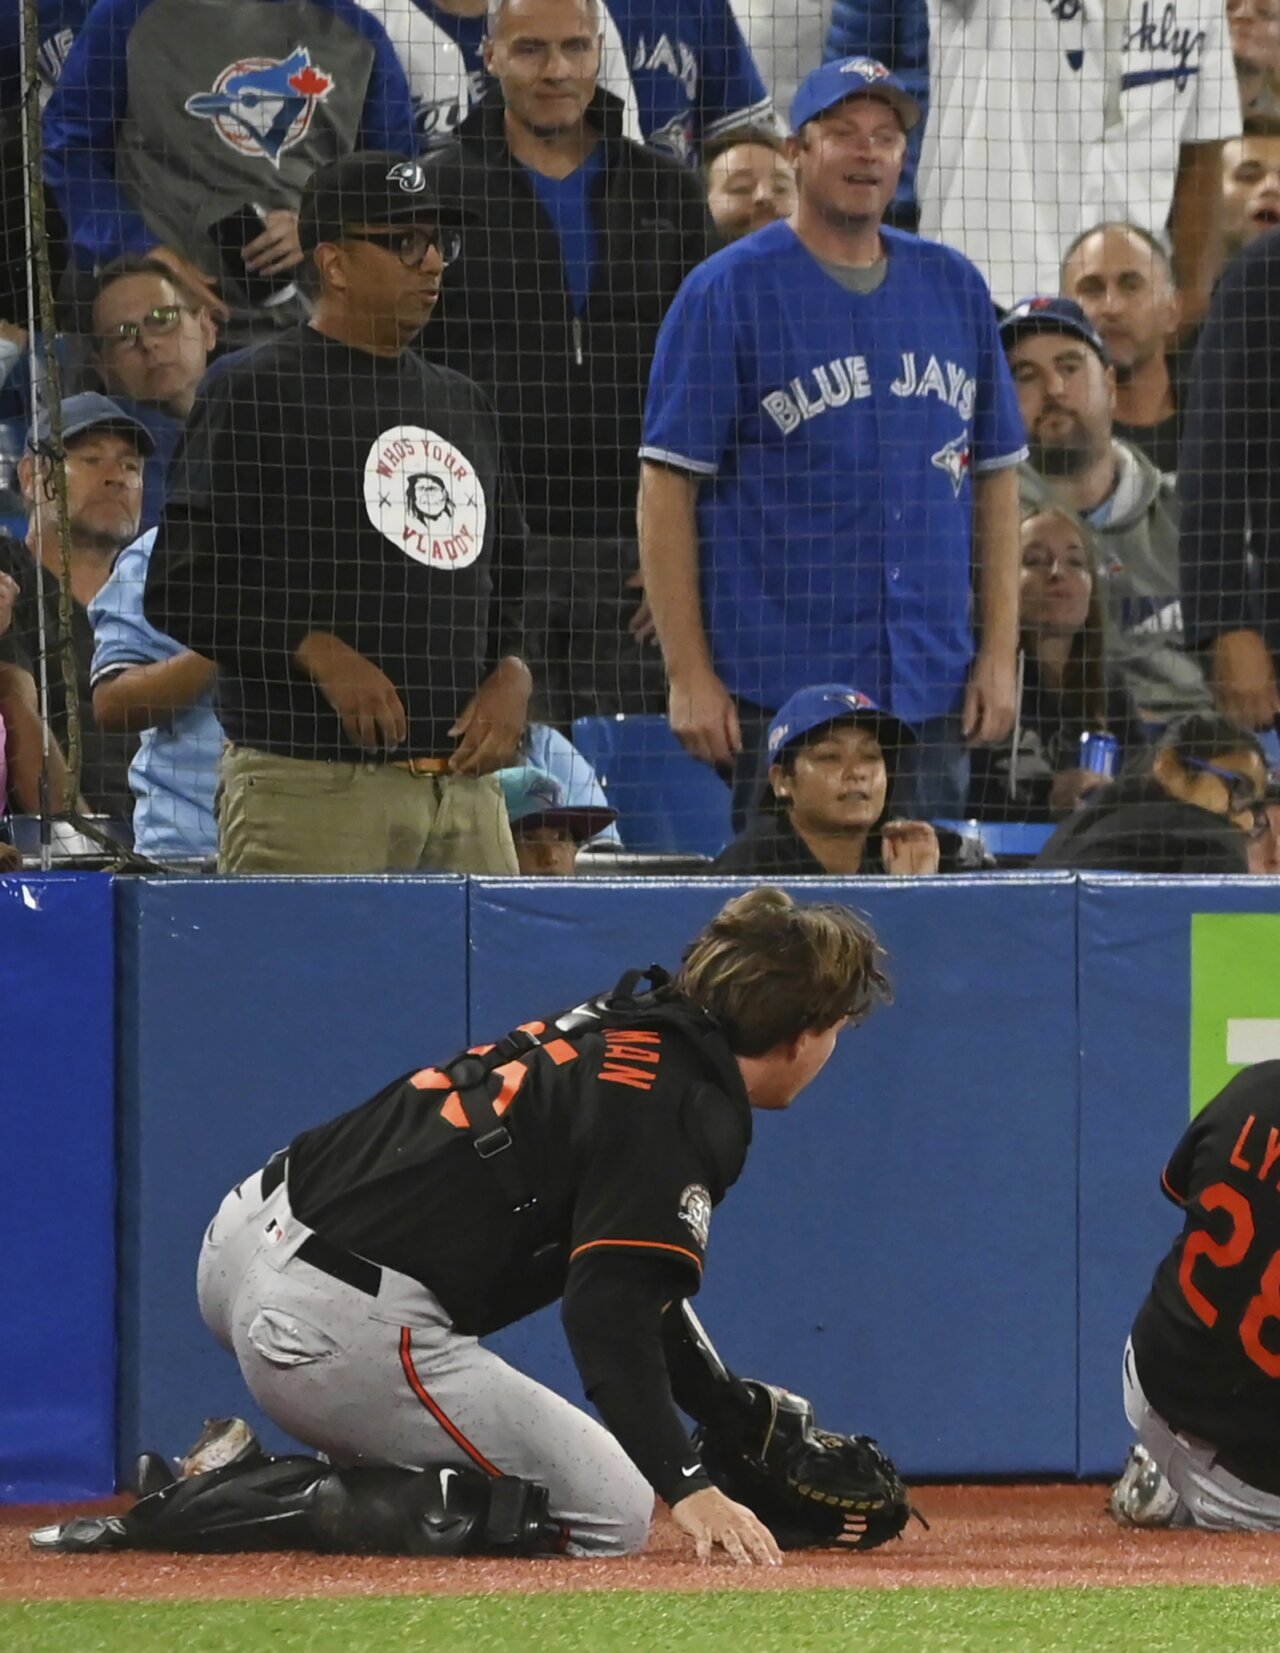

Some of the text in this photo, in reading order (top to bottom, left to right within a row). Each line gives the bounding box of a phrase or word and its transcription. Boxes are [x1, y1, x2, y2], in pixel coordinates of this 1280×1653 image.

[761, 352, 977, 435] BLUE JAYS
[421, 439, 468, 482] YOUR
[402, 524, 475, 560] VLADDY
